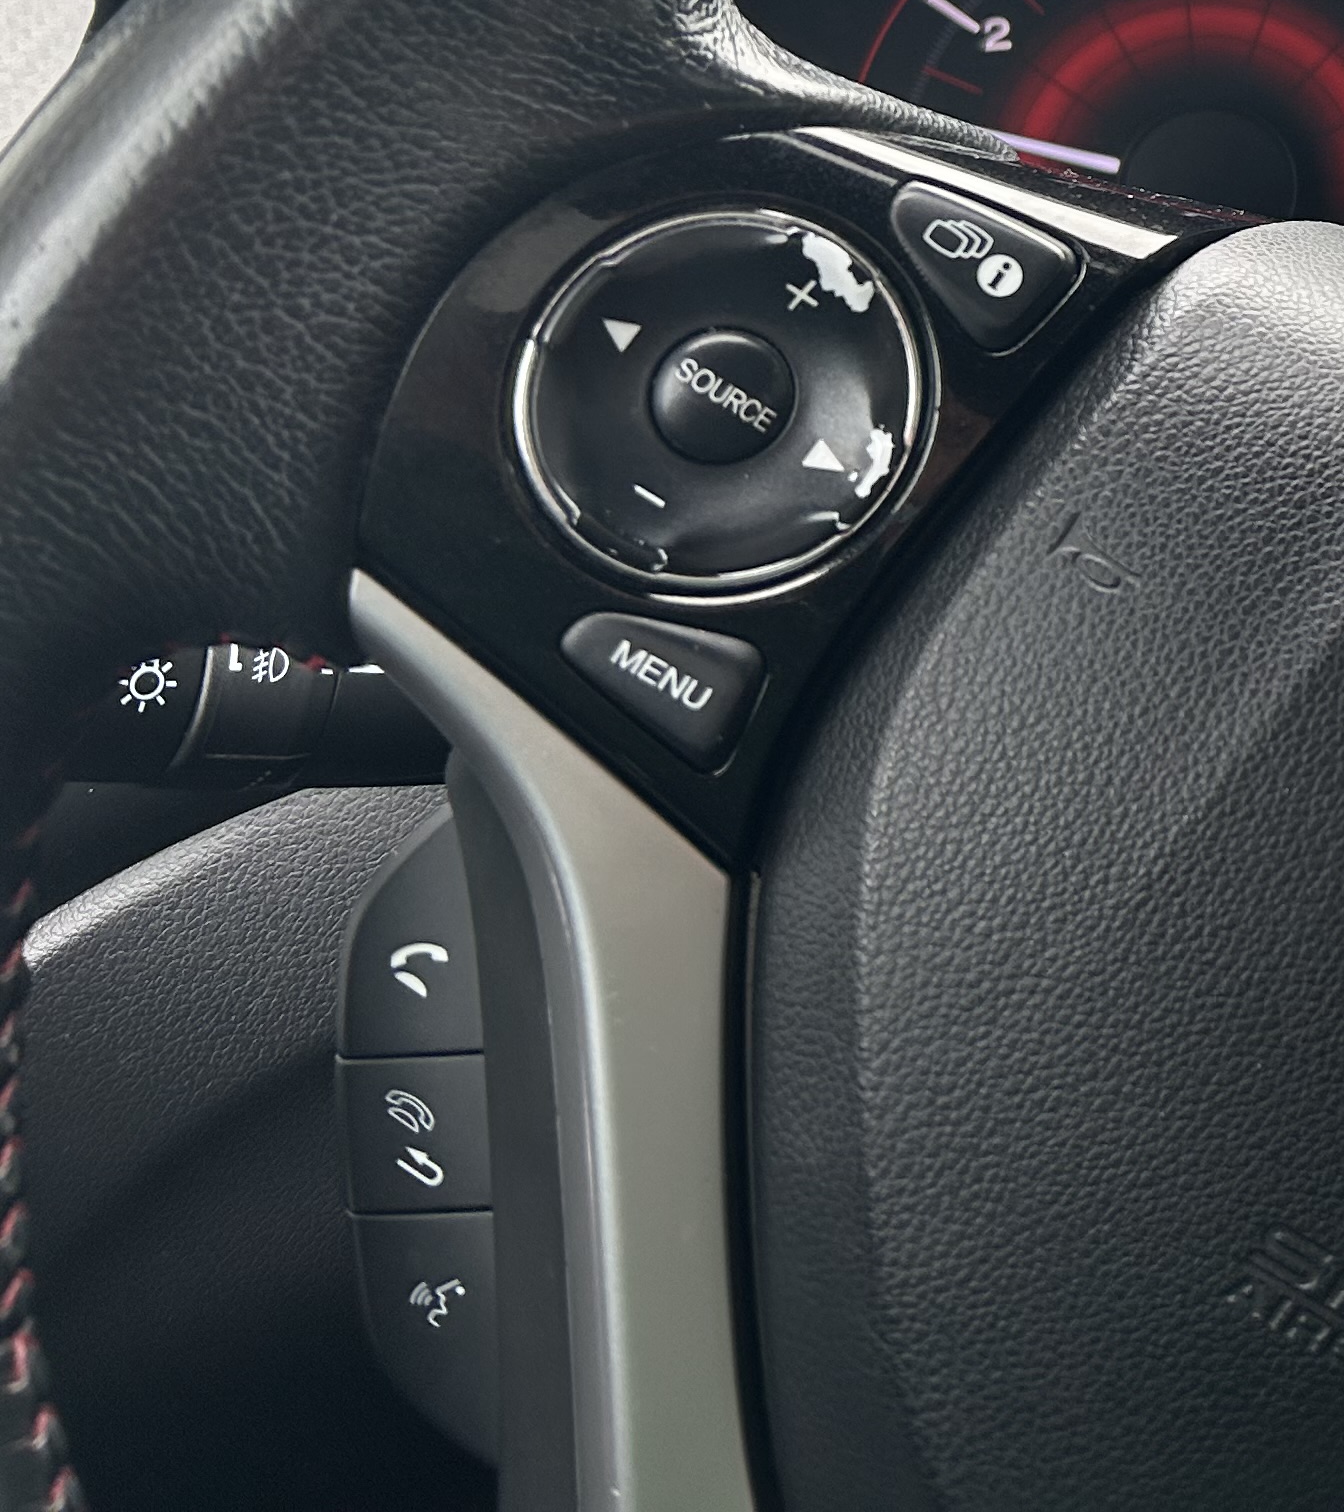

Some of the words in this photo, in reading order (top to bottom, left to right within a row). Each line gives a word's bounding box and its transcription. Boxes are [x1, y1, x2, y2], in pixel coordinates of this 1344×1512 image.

[981, 16, 1013, 53] 2
[673, 357, 777, 434] SOURCE
[610, 639, 714, 712] MENU
